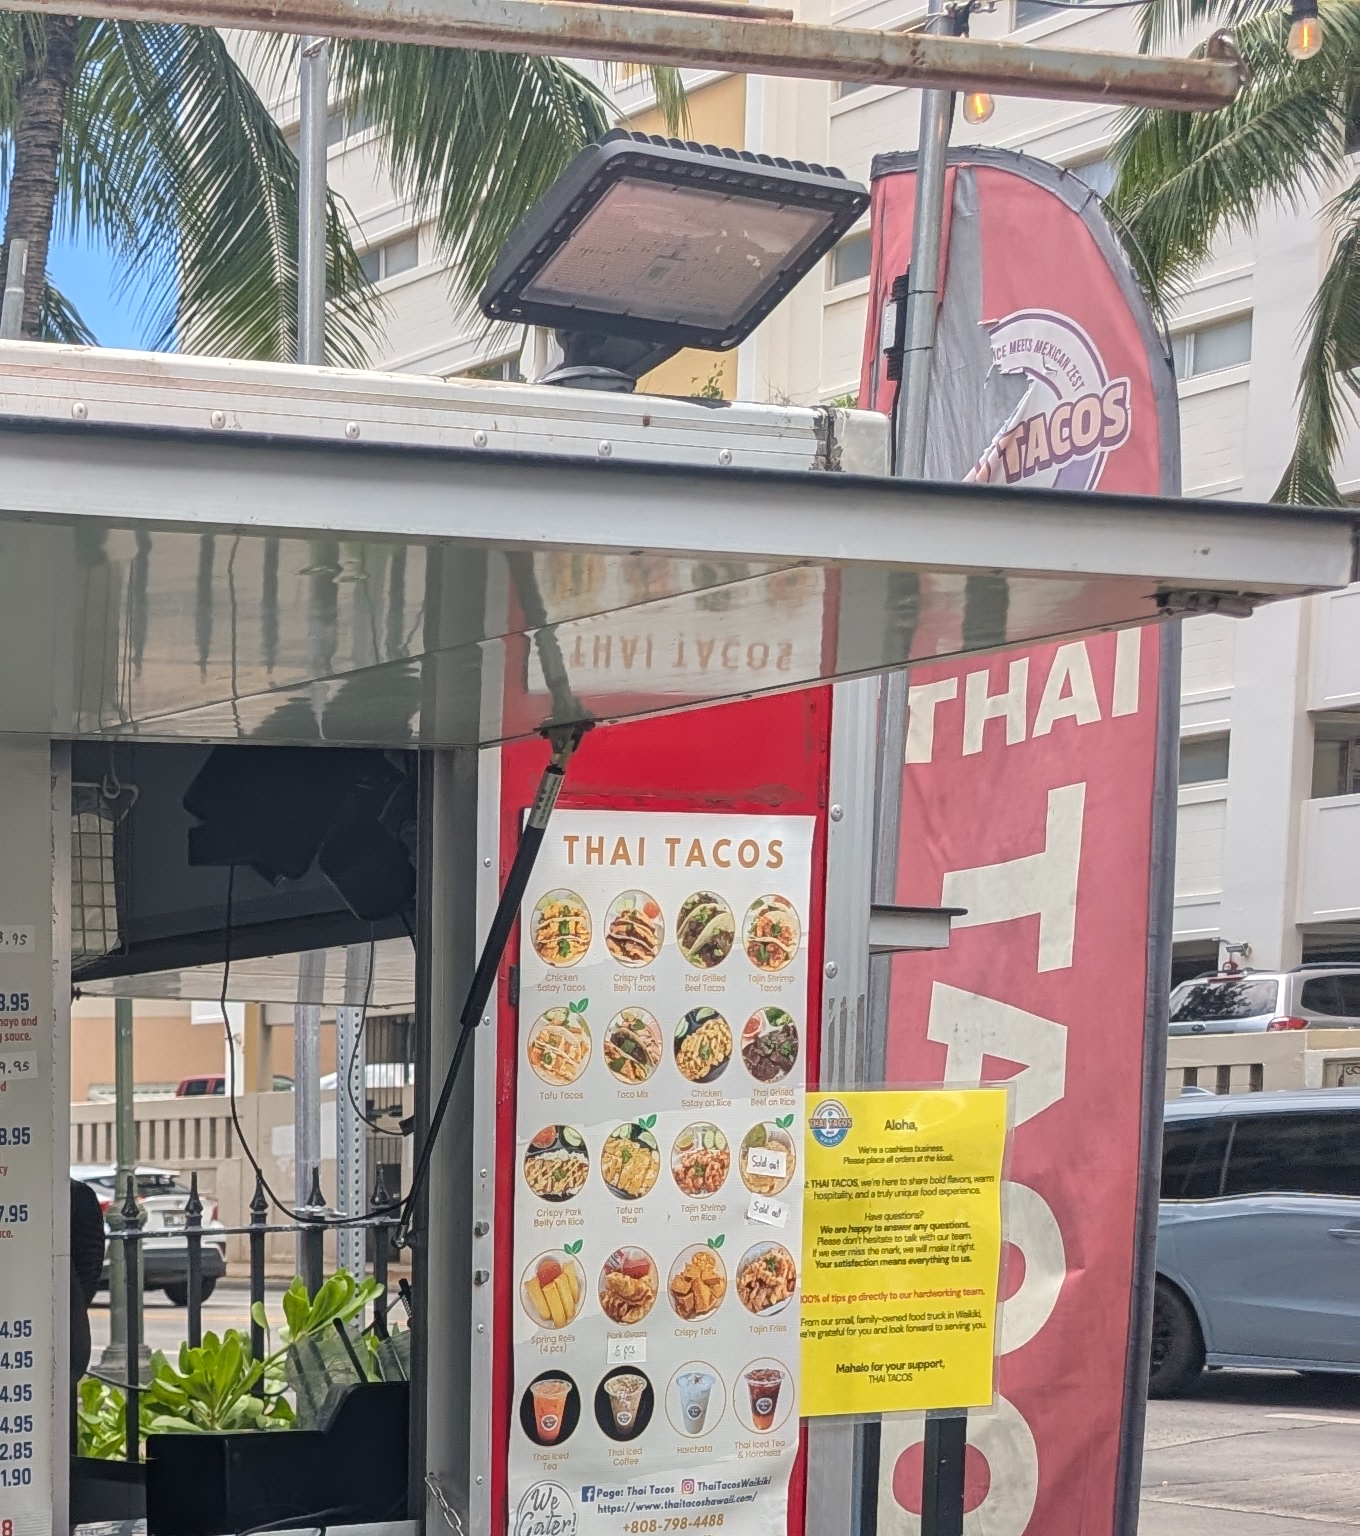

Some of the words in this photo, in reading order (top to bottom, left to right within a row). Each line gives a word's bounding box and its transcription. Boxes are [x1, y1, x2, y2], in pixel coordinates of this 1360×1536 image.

[1010, 339, 1032, 354] MEETS
[1034, 340, 1071, 370] MEXICAN
[1066, 364, 1085, 391] ZEST
[997, 381, 1130, 484] TACOS
[905, 626, 1142, 764] THAI
[563, 835, 645, 866] THAI
[665, 838, 783, 868] TACOS
[884, 1119, 917, 1131] Aloha,
[675, 1328, 698, 1338] Crispy
[700, 1326, 716, 1336] Tofu
[836, 1363, 868, 1373] Mahalo
[871, 1362, 883, 1371] for
[886, 1361, 905, 1373] your
[908, 1359, 945, 1370] support,
[887, 1373, 912, 1382] TACOS
[677, 1445, 712, 1454] Horchata
[597, 1488, 623, 1498] Page:
[627, 1486, 646, 1495] Thai
[649, 1484, 674, 1495] Tacos
[623, 1514, 724, 1533] +808-798-4488
